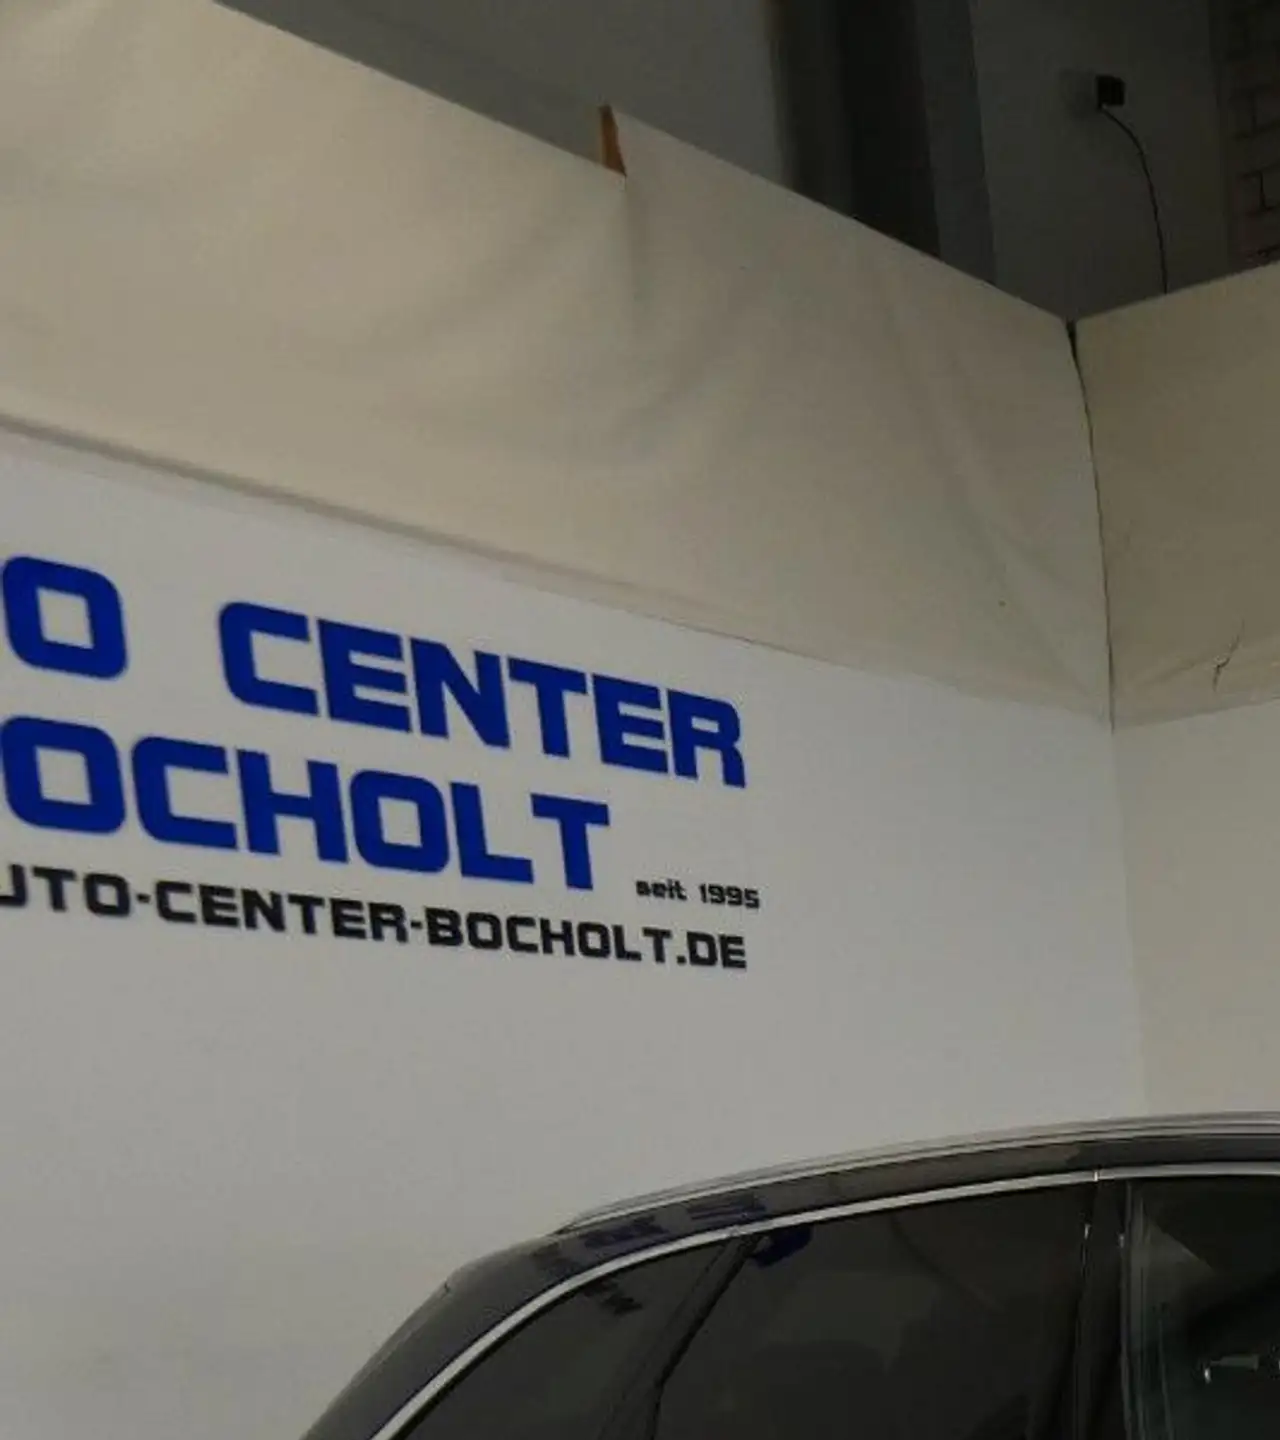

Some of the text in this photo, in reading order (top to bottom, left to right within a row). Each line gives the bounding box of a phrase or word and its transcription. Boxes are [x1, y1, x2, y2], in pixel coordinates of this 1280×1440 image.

[218, 600, 746, 788] CENTER
[0, 715, 611, 890] OCHOLT
[635, 879, 760, 910] seit 1995
